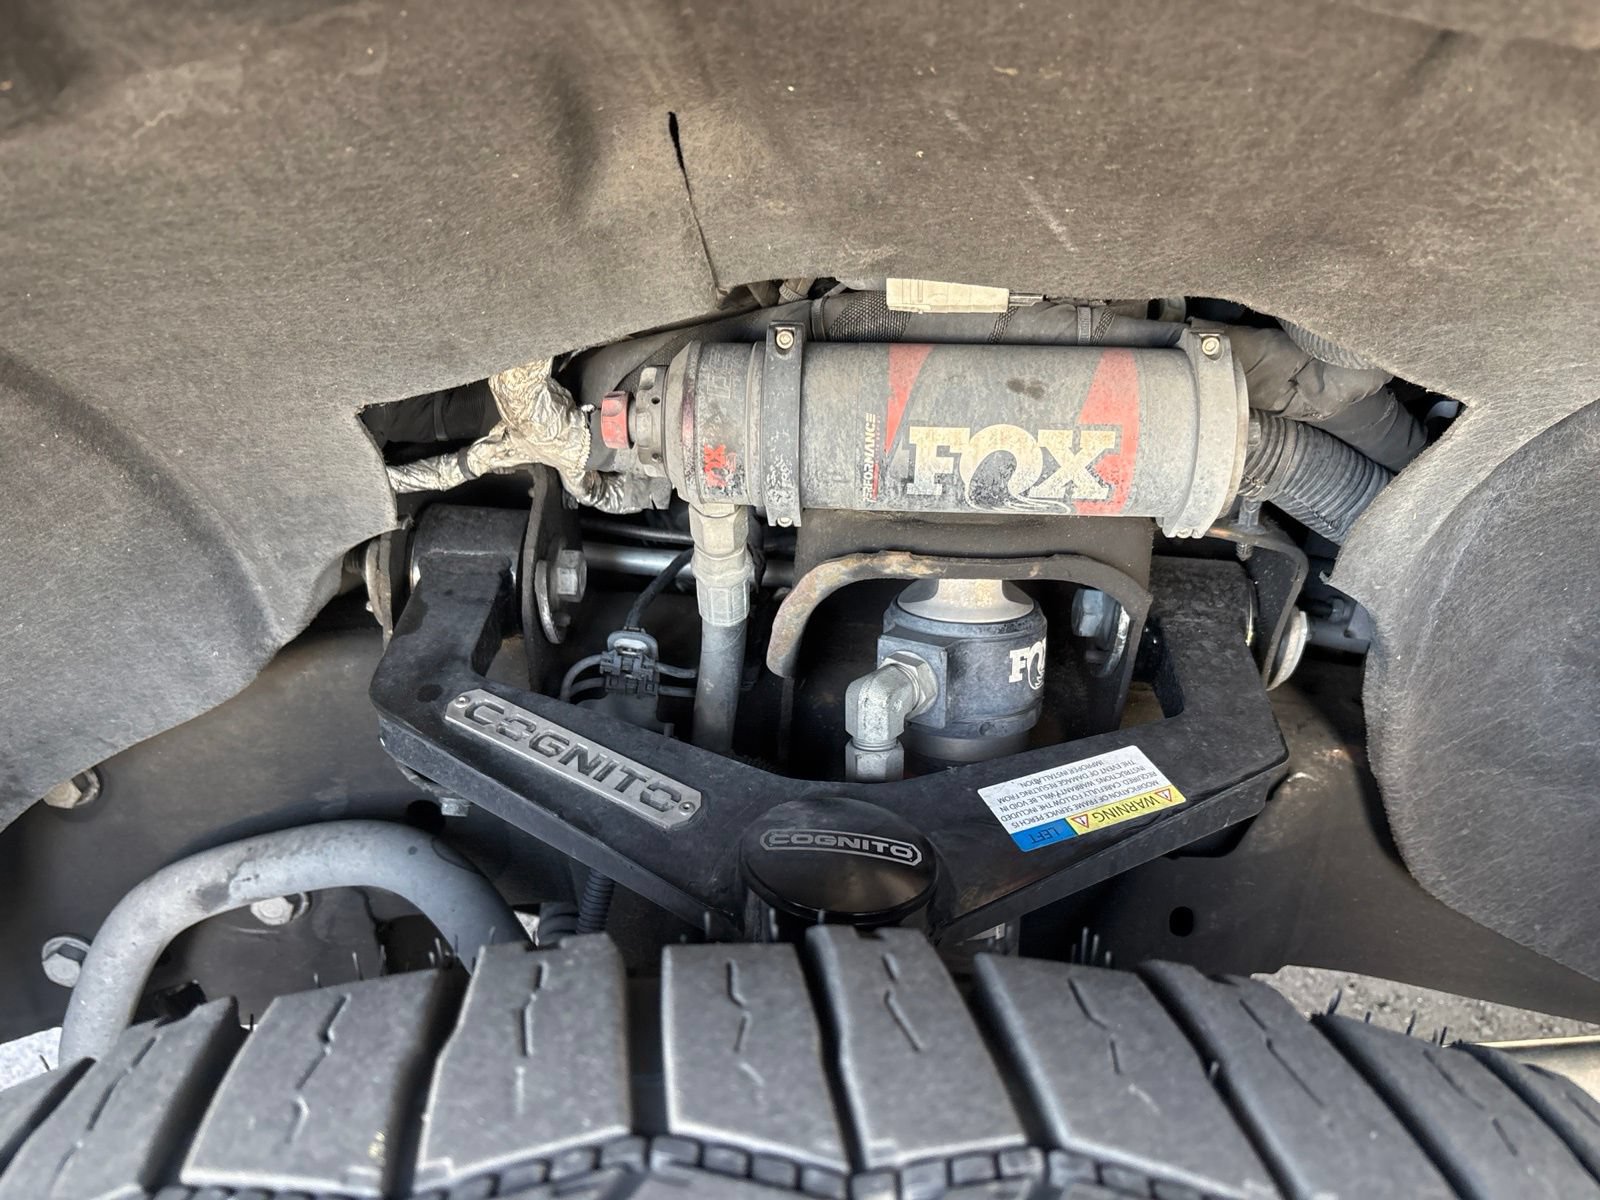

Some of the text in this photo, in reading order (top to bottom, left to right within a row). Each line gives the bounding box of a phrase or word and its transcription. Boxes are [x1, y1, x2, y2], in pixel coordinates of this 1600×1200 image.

[907, 424, 1116, 512] FOX
[1009, 638, 1046, 690] FO
[464, 700, 682, 812] COGNITO
[1119, 759, 1136, 767] THE
[1066, 759, 1104, 774] IMPROPER
[1098, 763, 1122, 773] EVENT
[1057, 773, 1089, 786] DAMAGE
[1018, 782, 1058, 797] RESULTING
[1053, 780, 1095, 796] WARRANTY
[1081, 781, 1122, 797] CAREFULLY
[1107, 779, 1159, 798] MODIFICATION
[996, 793, 1020, 803] FROM
[1036, 791, 1056, 801] WILL
[1051, 793, 1083, 806] FOLLOW
[1096, 794, 1109, 802] OF
[1007, 800, 1029, 809] VOID
[1036, 802, 1053, 810] THE
[1071, 798, 1098, 809] FRAME
[1090, 794, 1160, 822] WARNING
[999, 806, 1039, 822] INCLUDED
[1042, 805, 1074, 818] SERVICE
[1018, 814, 1045, 826] PERCH
[1025, 826, 1060, 843] LEFT
[768, 833, 913, 859] COGNITO
